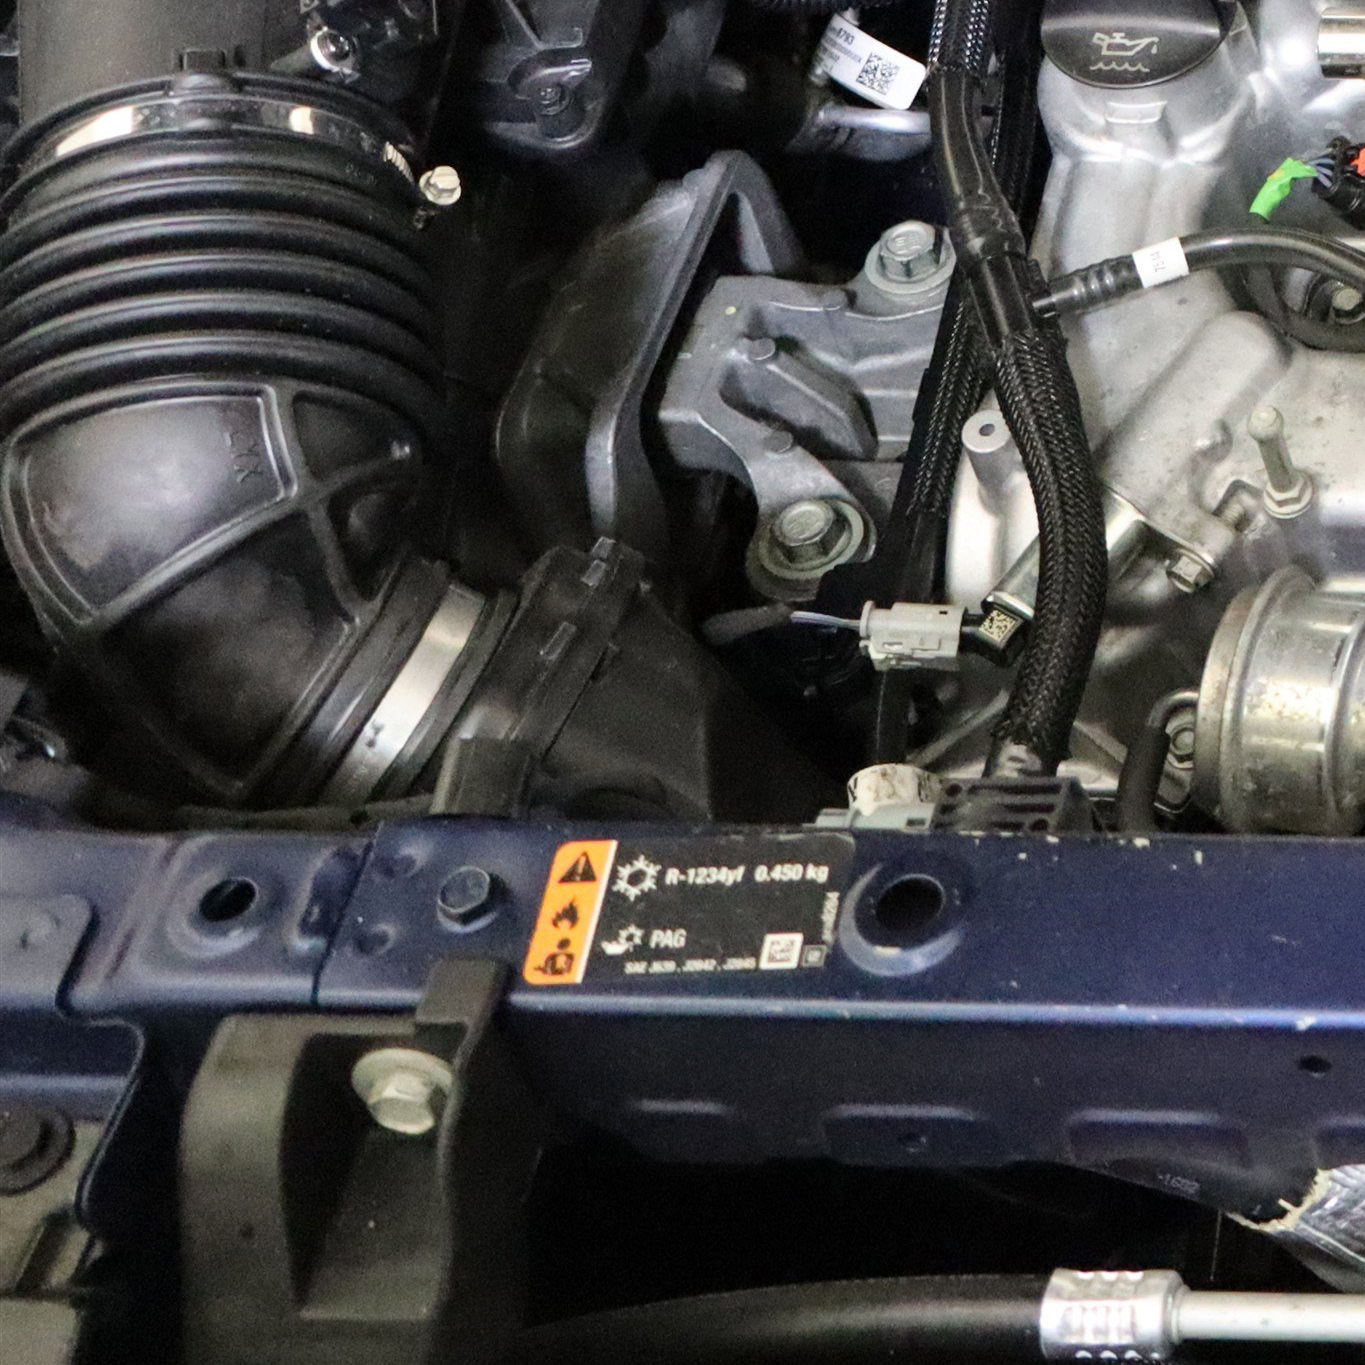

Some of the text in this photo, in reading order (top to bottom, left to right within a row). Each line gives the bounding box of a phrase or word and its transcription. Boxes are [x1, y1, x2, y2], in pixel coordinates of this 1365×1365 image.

[664, 864, 830, 887] R-1234yf 0.450 kg
[650, 929, 687, 949] PAG
